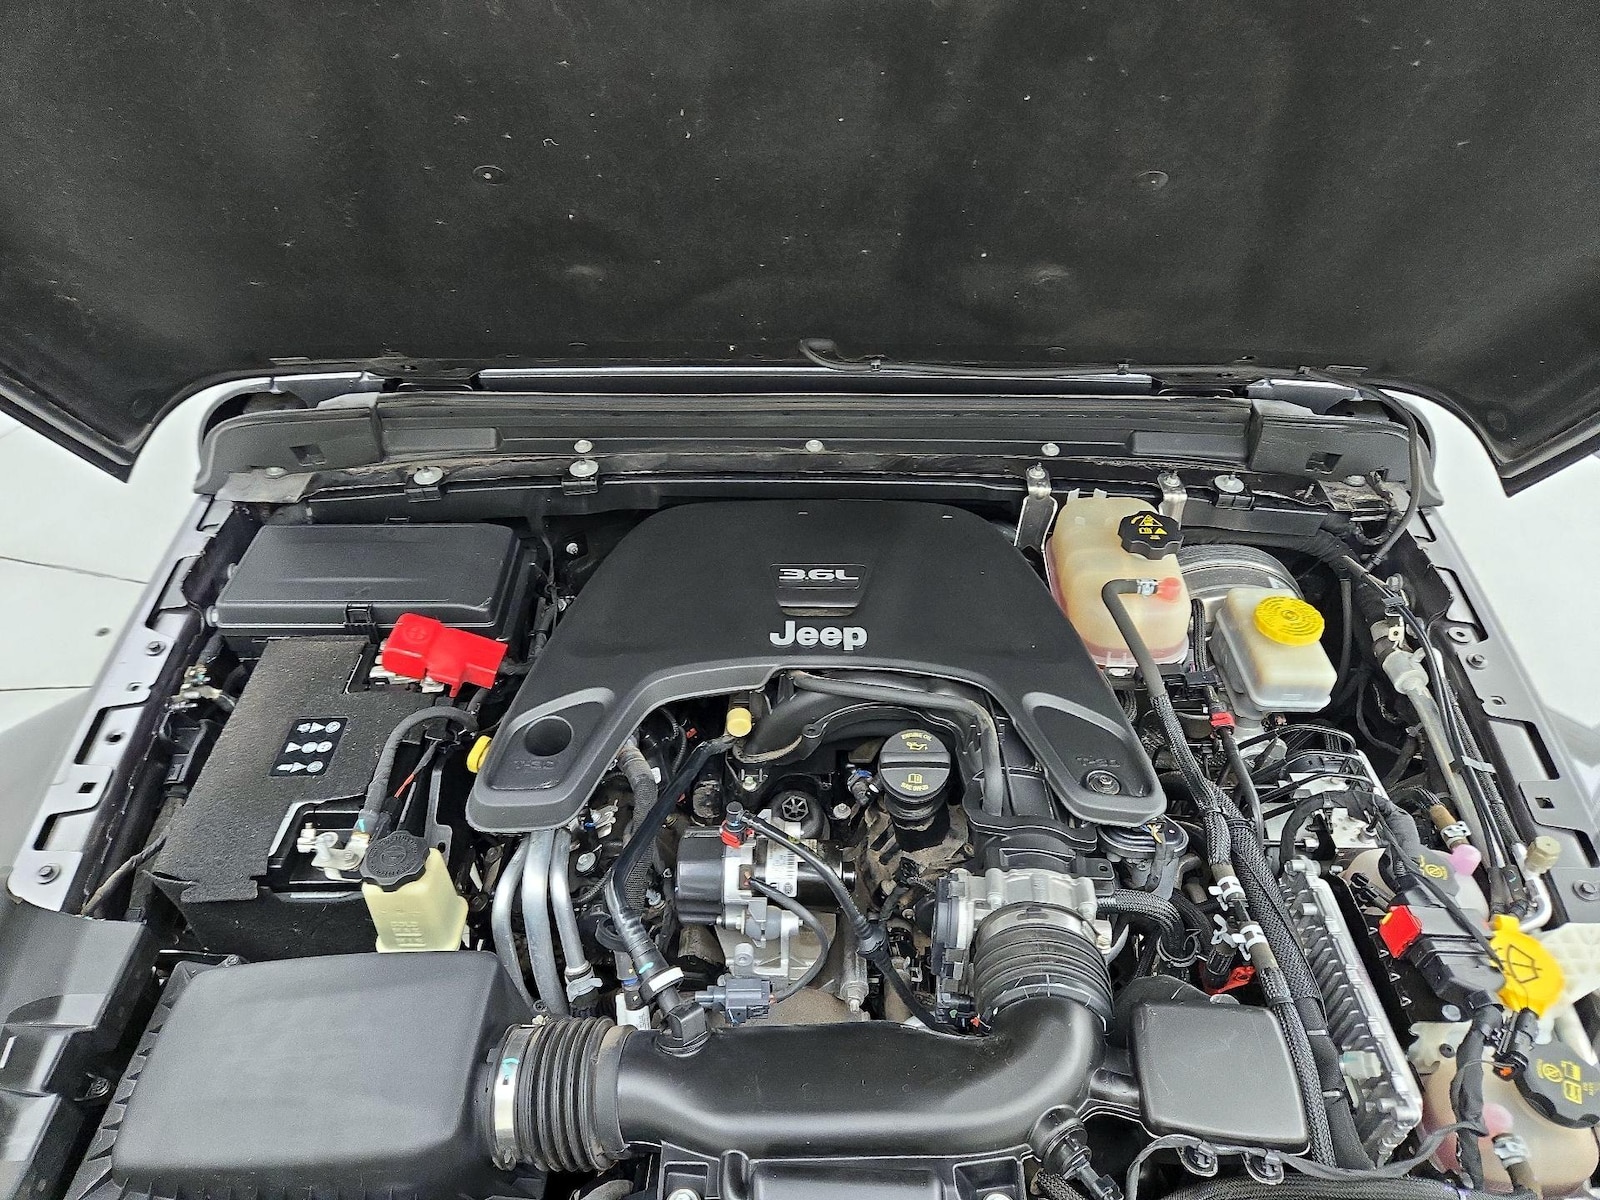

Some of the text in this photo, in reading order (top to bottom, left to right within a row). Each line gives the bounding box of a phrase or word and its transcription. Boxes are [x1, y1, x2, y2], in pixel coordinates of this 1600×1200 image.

[778, 568, 859, 581] 3.6L
[769, 620, 868, 651] Jeep
[900, 732, 933, 742] ENGINE OIL
